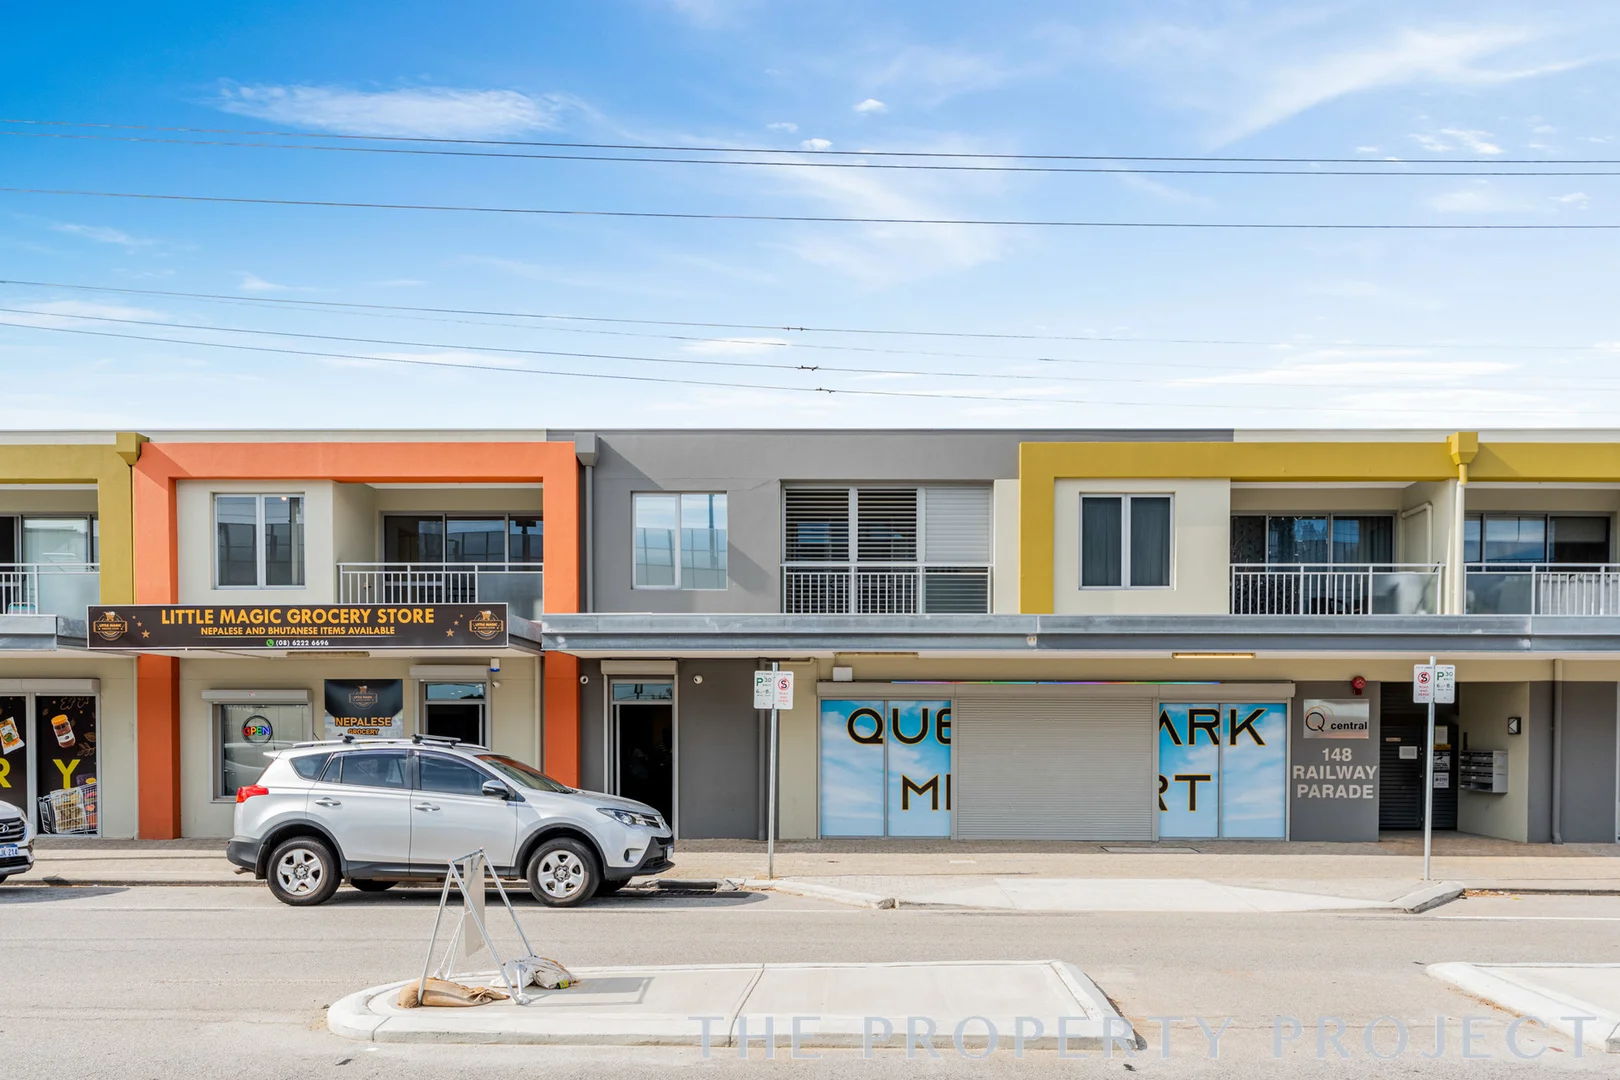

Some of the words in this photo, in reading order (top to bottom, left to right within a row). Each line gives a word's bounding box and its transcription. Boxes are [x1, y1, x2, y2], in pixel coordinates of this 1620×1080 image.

[161, 609, 214, 625] LITTLE
[219, 608, 282, 624] MAGIC
[286, 608, 372, 624] GROCERY
[377, 608, 435, 624] STORE
[200, 626, 243, 635] NEPALESE
[245, 626, 266, 635] AND
[268, 626, 318, 635] BHUTANESE
[320, 626, 346, 635] ITEMS
[348, 626, 395, 635] AVAILABLE
[275, 639, 290, 647] (08)
[1437, 671, 1445, 680] P
[756, 677, 763, 686] P
[335, 716, 393, 727] NEPALESE
[1330, 721, 1368, 730] central
[243, 725, 271, 737] OPEN
[1322, 747, 1352, 761] 148
[1293, 765, 1378, 780] RAILWAY
[1297, 784, 1374, 799] PARADE
